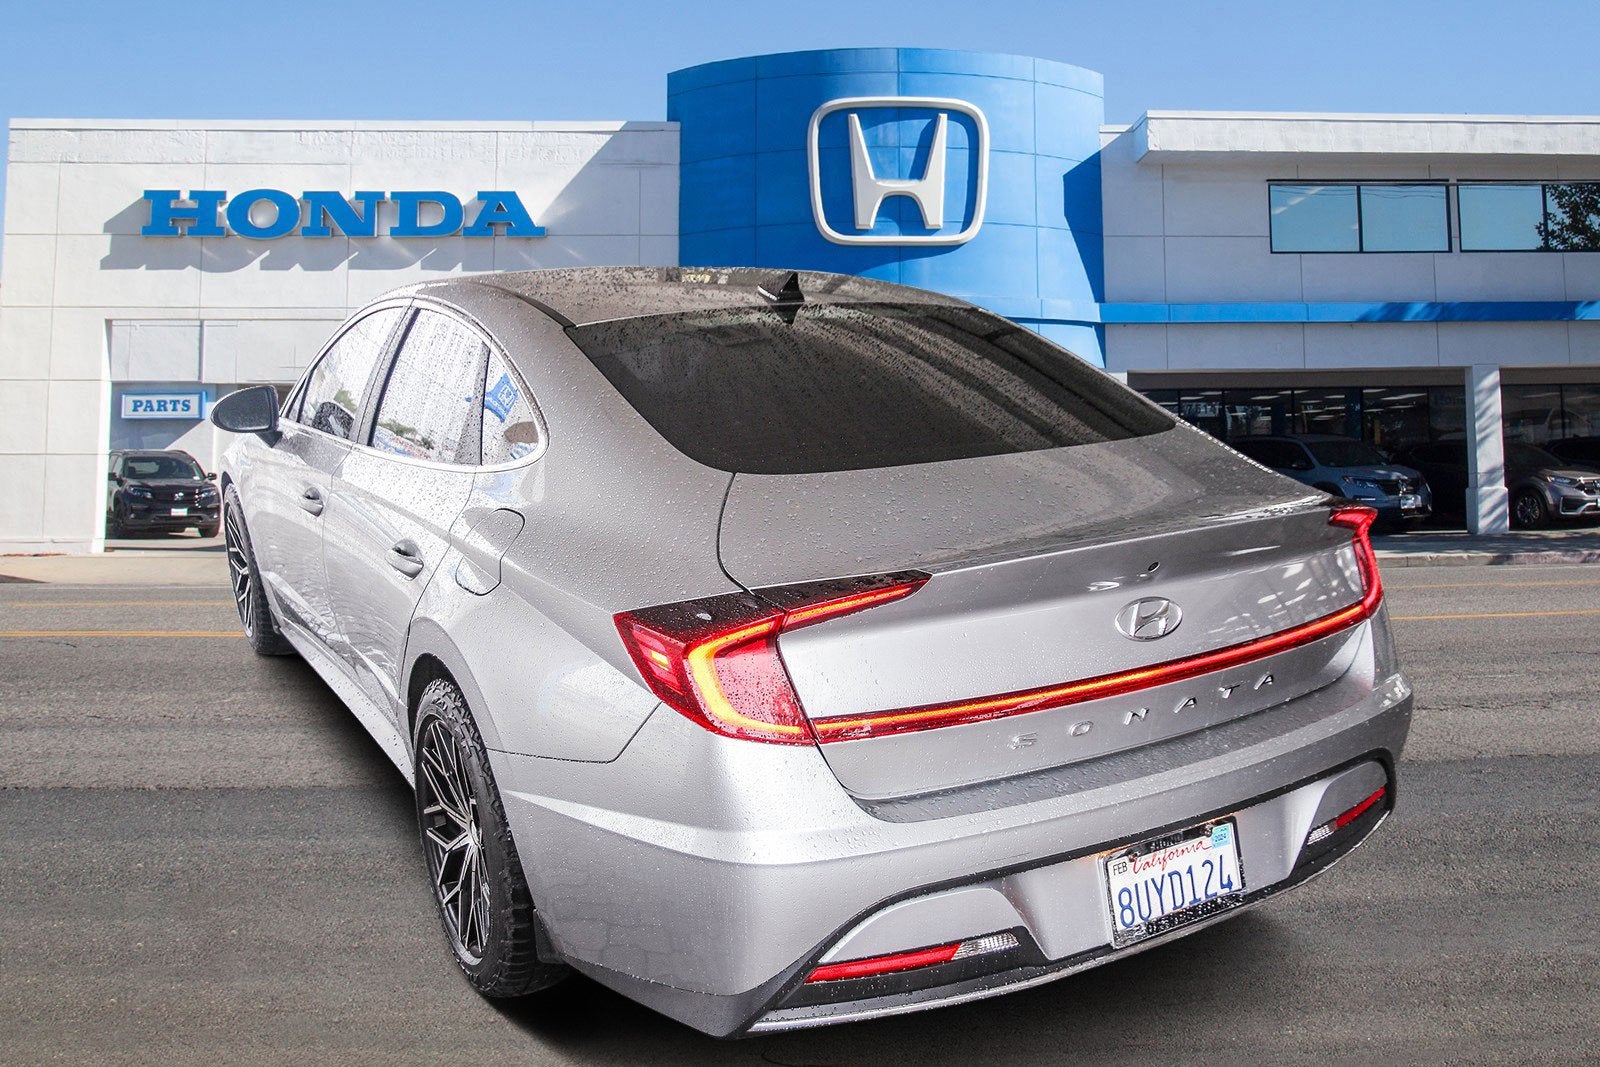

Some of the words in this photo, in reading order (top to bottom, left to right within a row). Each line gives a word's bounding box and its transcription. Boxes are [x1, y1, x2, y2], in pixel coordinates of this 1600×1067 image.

[141, 188, 547, 240] HONDA
[132, 399, 191, 412] PARTS
[1008, 673, 1274, 749] SONATA
[1112, 861, 1128, 876] FEB
[1132, 840, 1212, 875] California
[1118, 855, 1233, 928] 8UYD124
